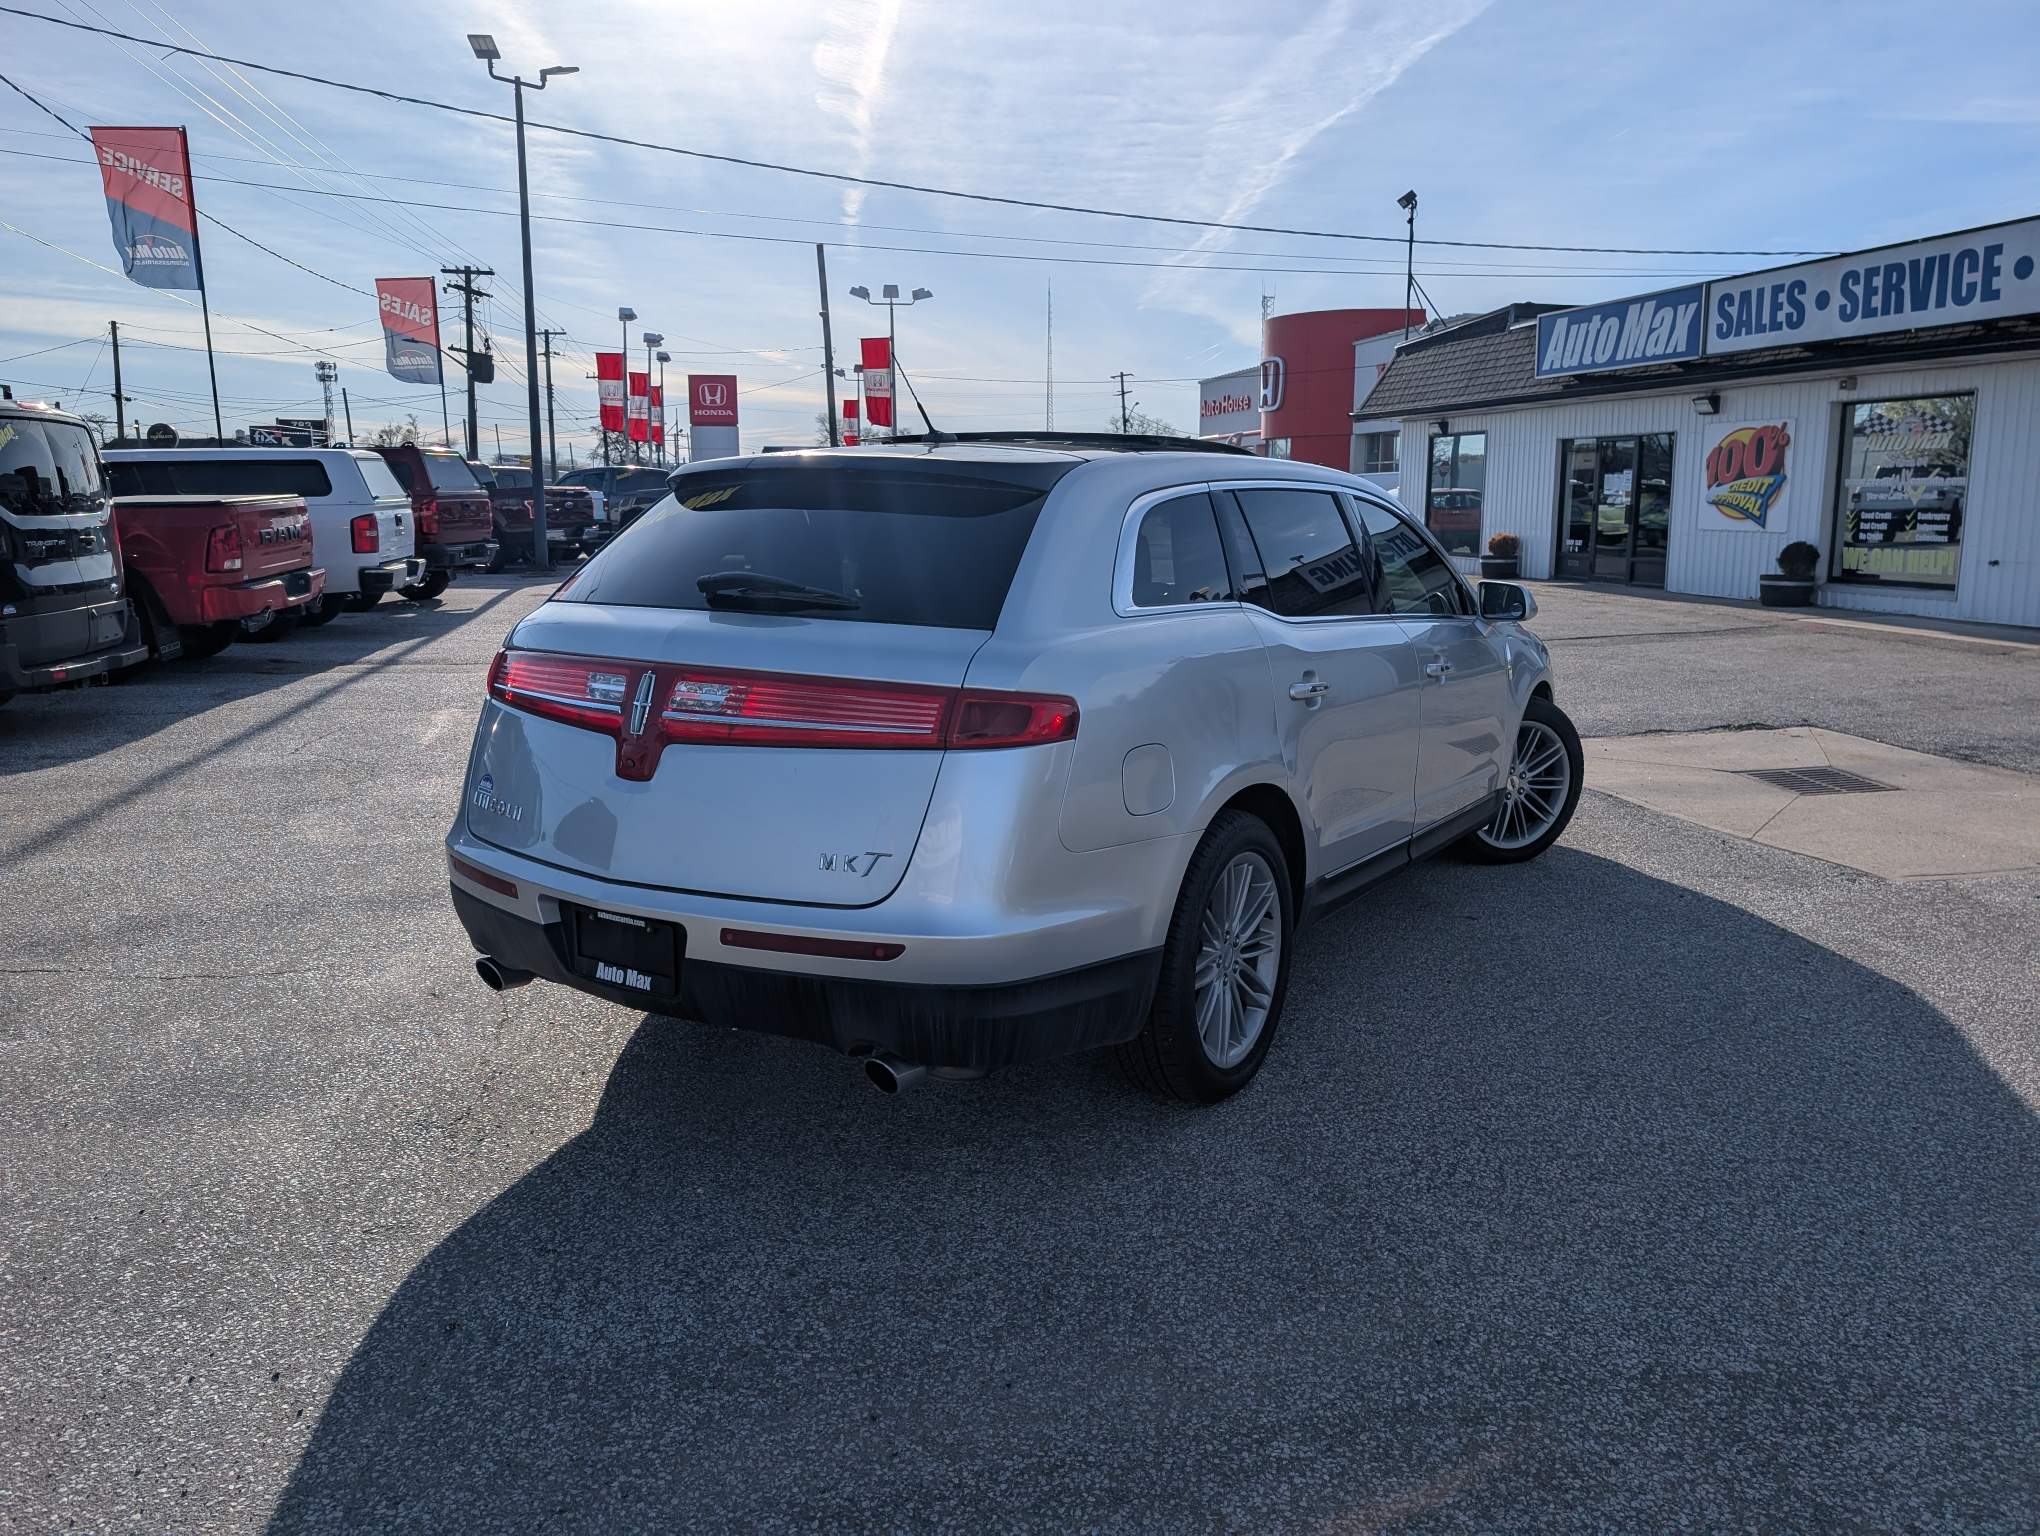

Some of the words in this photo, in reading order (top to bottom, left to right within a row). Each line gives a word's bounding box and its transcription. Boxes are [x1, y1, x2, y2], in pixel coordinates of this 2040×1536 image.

[1715, 279, 1807, 340] SALES
[1838, 243, 2004, 323] SERVICE
[1221, 393, 1250, 413] House
[1706, 421, 1791, 490] 100%
[260, 524, 302, 545] RAM
[596, 961, 625, 984] Auto
[625, 968, 652, 992] Max
